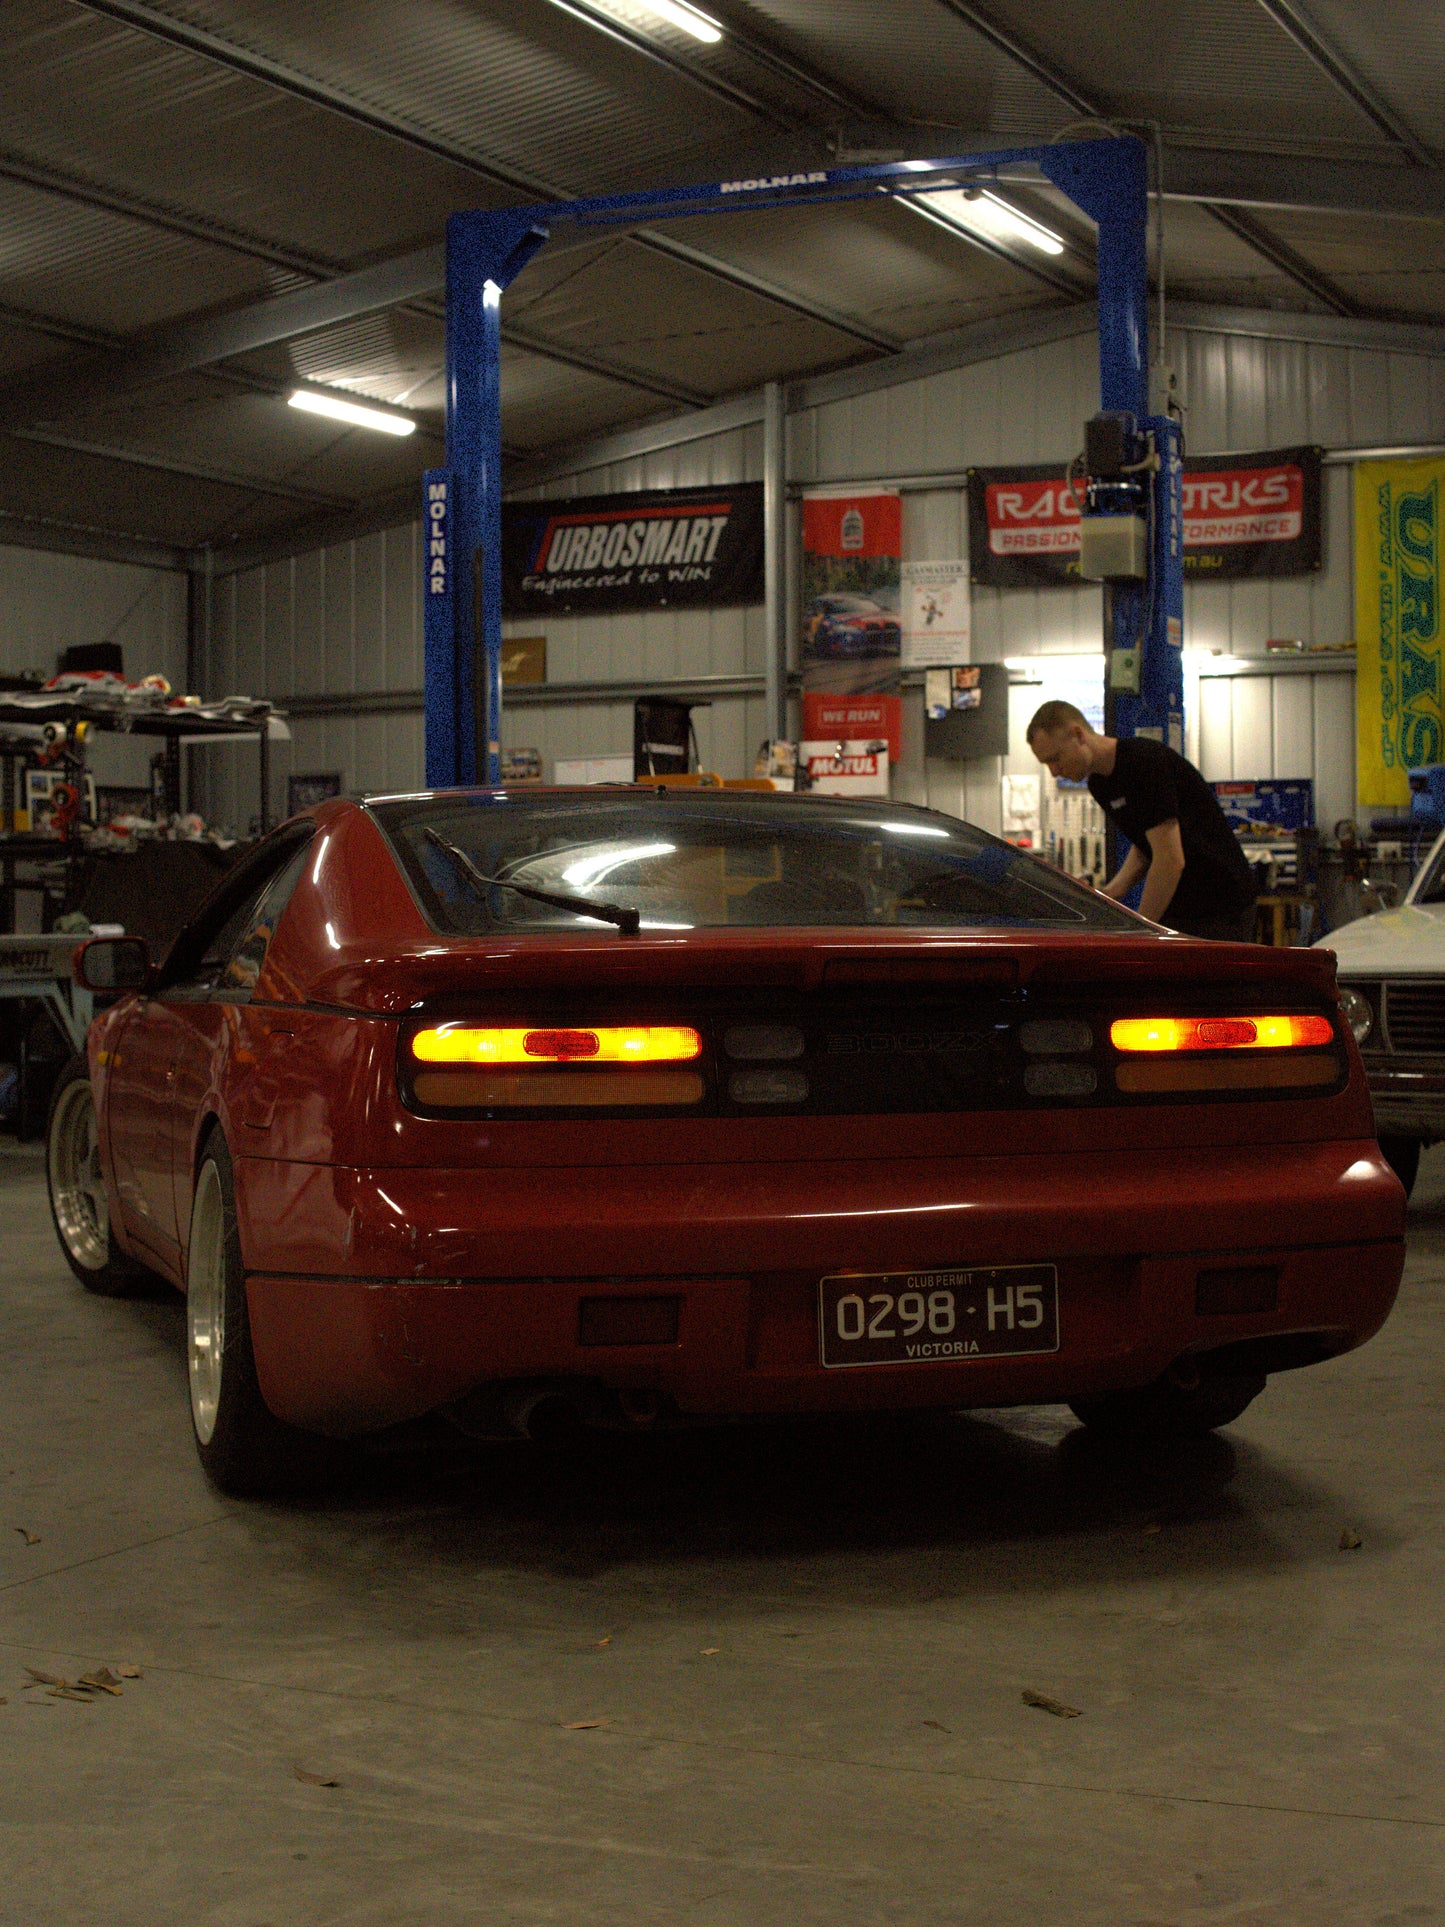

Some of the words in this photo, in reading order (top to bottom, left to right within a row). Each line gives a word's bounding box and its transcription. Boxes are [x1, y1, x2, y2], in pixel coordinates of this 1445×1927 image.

[720, 172, 828, 194] MOLNAR
[427, 483, 447, 595] MOLNAR
[1002, 531, 1081, 548] PASSION
[521, 570, 631, 596] Engineered
[638, 568, 660, 584] to
[668, 566, 712, 583] WIN
[1393, 480, 1443, 773] URAS
[821, 708, 845, 723] WE
[847, 707, 881, 722] RUN
[810, 756, 876, 775] MOTUL
[827, 1031, 1003, 1055] 300ZX
[907, 1275, 934, 1288] CLUB
[935, 1273, 973, 1287] PERMIT
[836, 1290, 955, 1340] 0298
[987, 1285, 1044, 1331] H5
[906, 1340, 980, 1358] VICTORIA
